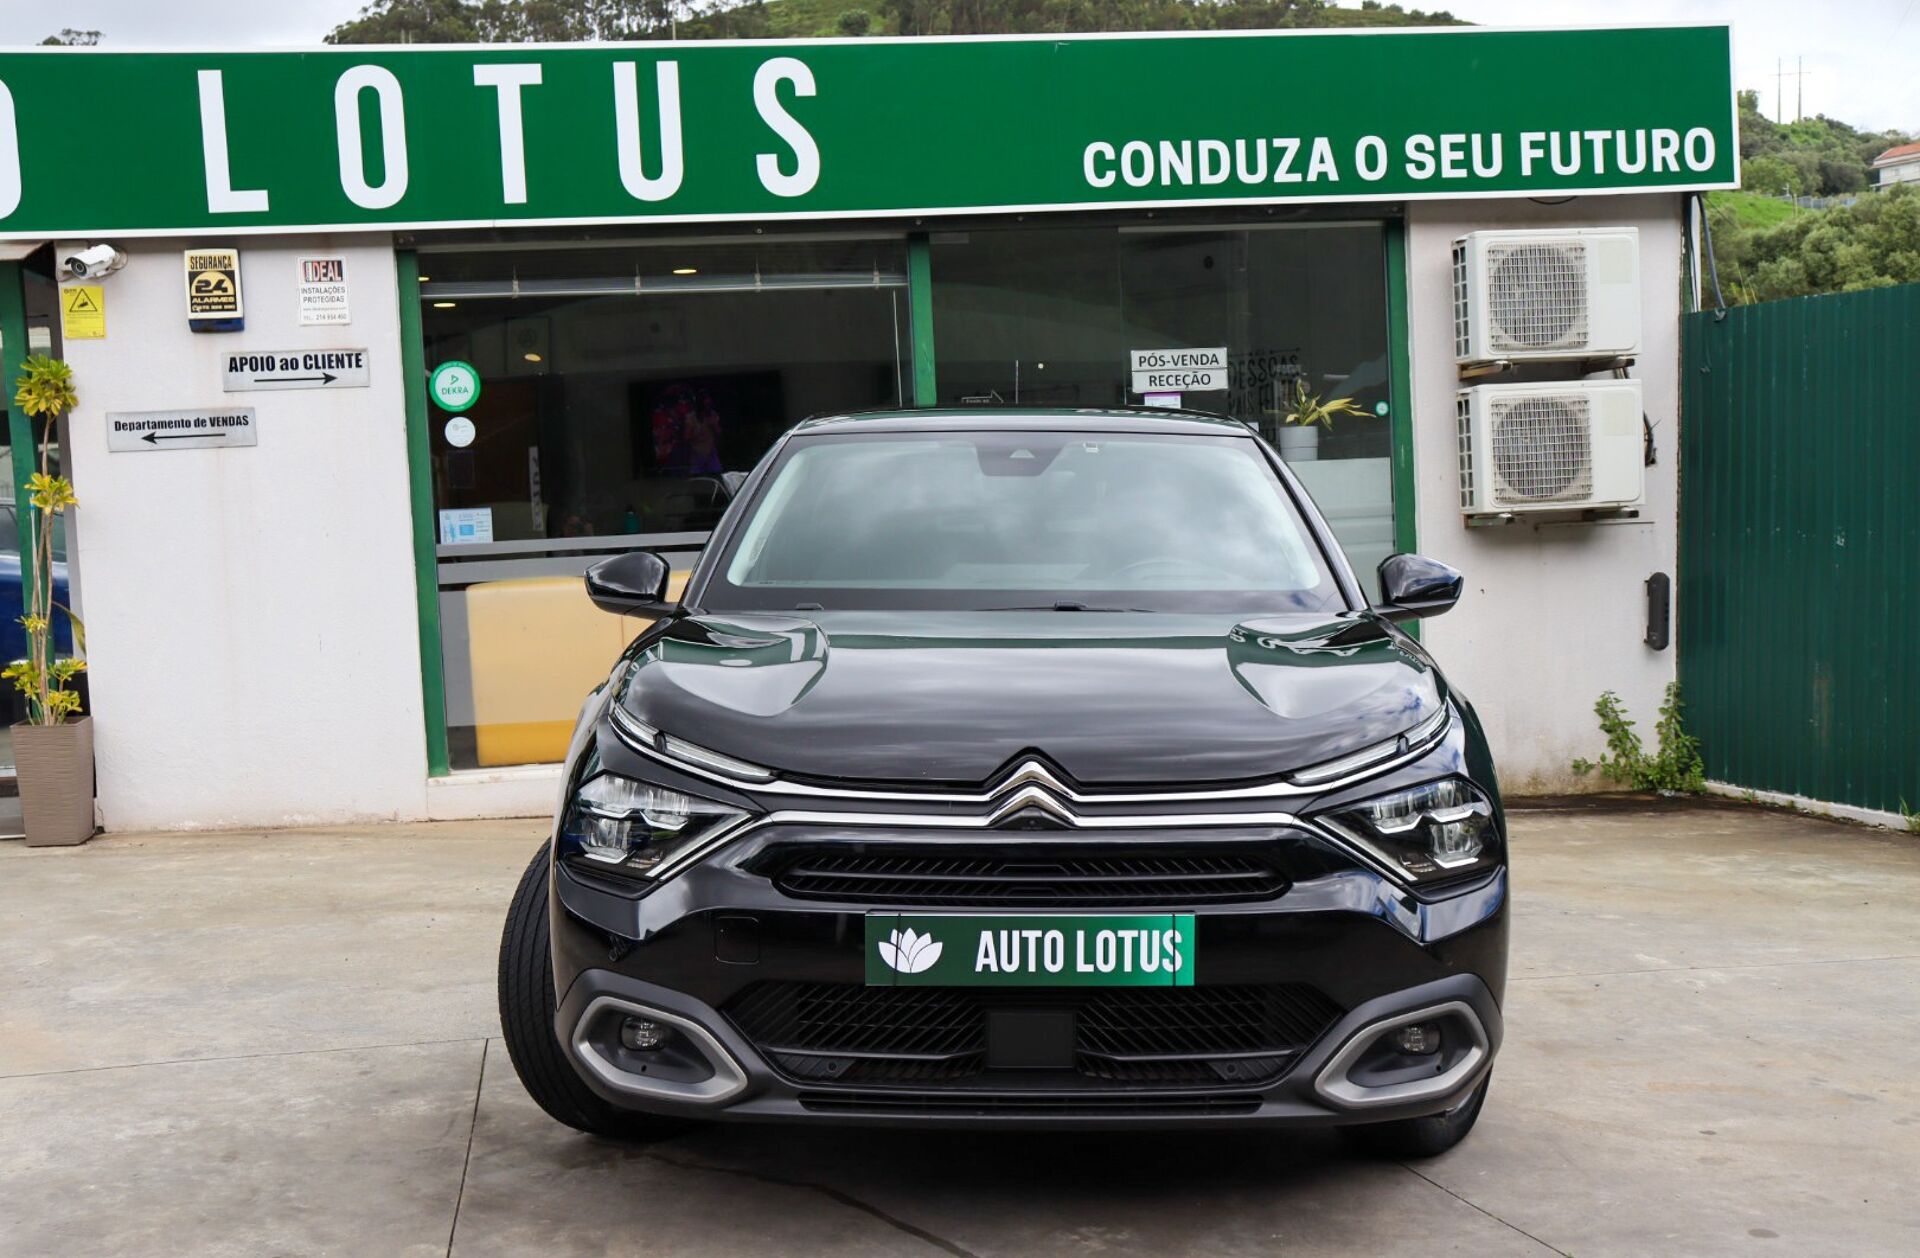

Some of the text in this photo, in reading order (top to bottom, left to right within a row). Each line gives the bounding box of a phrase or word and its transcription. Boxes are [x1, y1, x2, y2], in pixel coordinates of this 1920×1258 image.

[198, 57, 820, 212] LOTUS
[1083, 127, 1716, 187] CONDUZA O SEU FUTURO
[190, 255, 232, 270] SEGURANÇA
[195, 279, 228, 293] 24
[301, 286, 346, 295] INSTALAÇÕES
[303, 295, 345, 303] PROTEGIDAS
[229, 352, 363, 373] APOIO ao CLIENTE
[1138, 353, 1220, 368] PÓS-VENDA
[1149, 371, 1211, 389] RECEÇÃO
[441, 386, 469, 396] DEKRA
[114, 415, 249, 432] Departamento de VENDAS
[975, 930, 1183, 973] AUTO LOTUS
